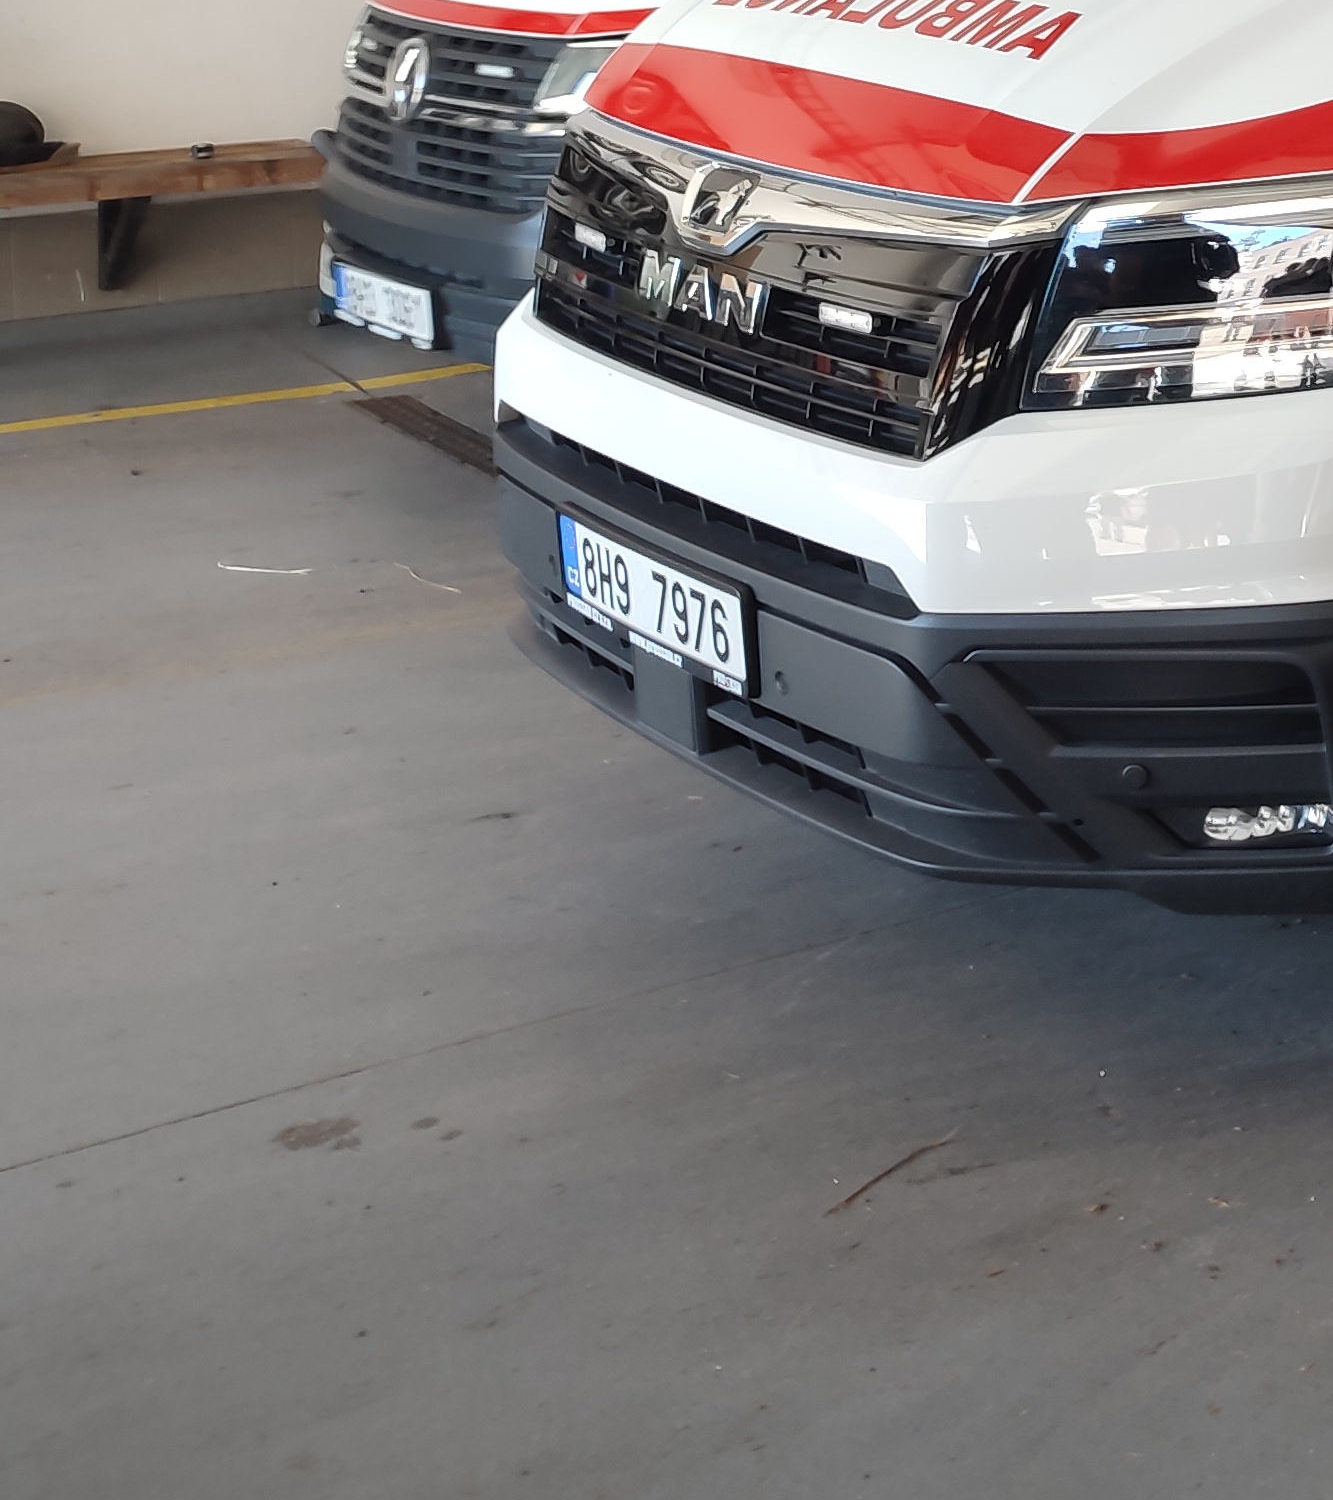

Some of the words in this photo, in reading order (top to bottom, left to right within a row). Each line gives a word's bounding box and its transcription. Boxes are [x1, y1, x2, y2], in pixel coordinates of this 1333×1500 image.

[638, 249, 769, 335] MAN
[582, 537, 631, 616] 8H9
[651, 568, 730, 664] 7976
